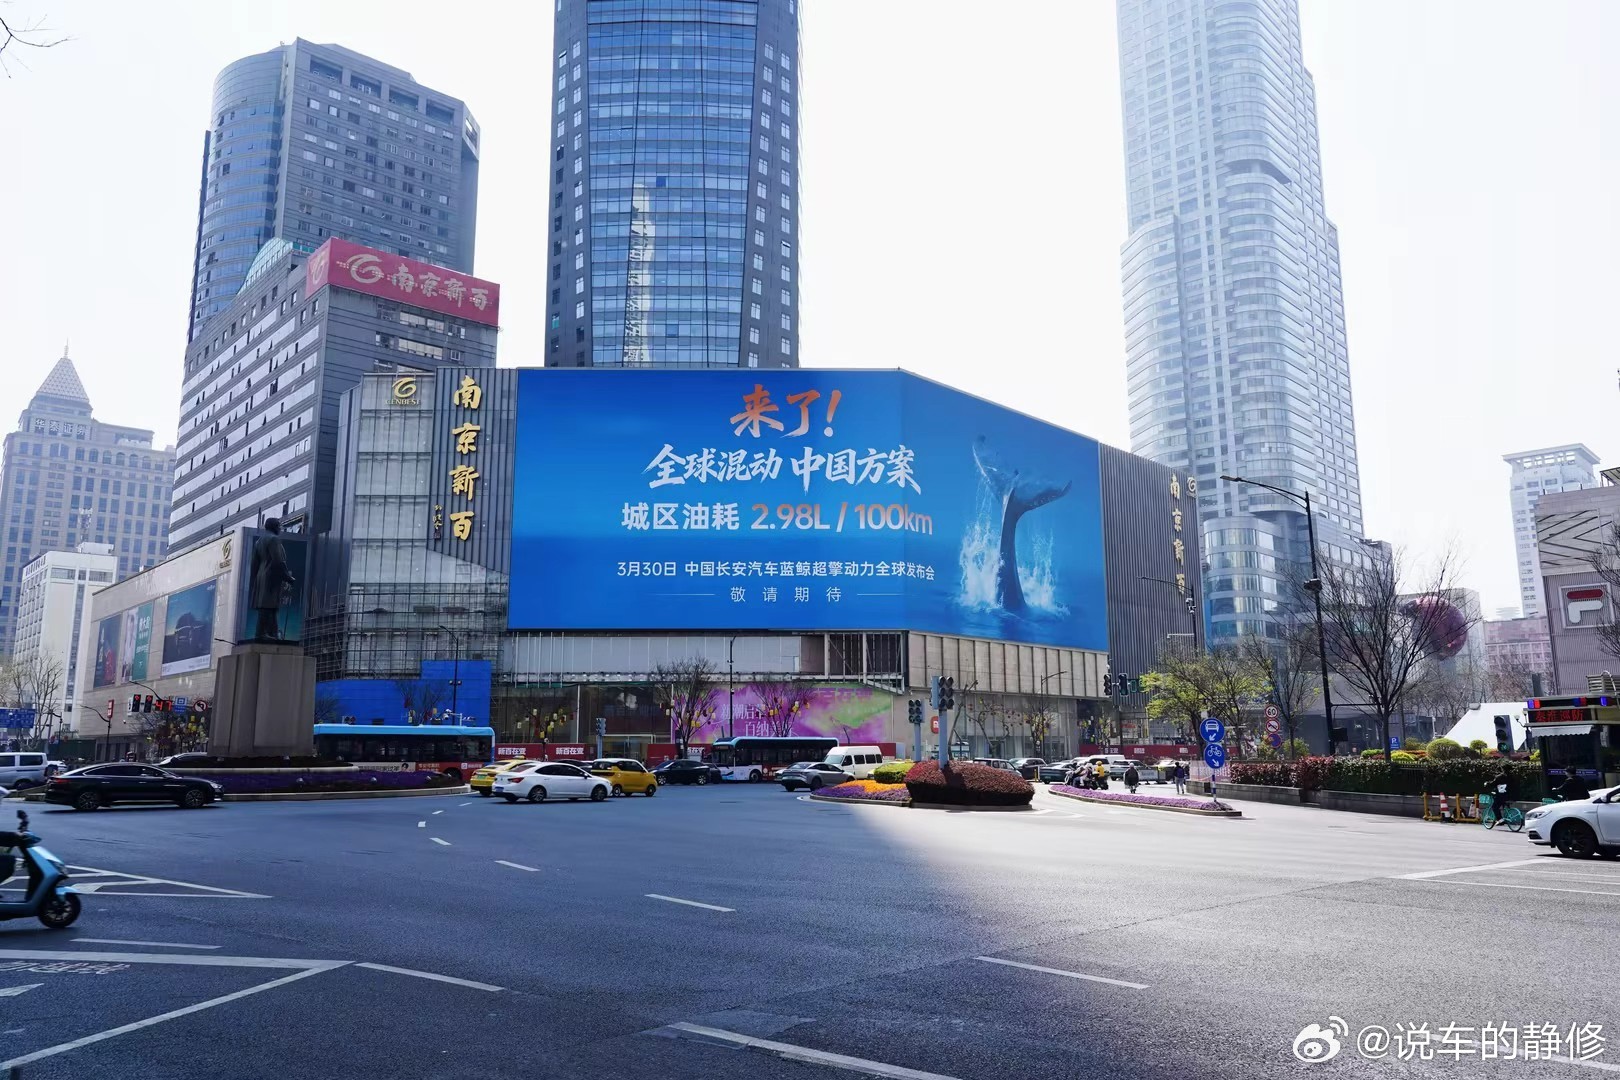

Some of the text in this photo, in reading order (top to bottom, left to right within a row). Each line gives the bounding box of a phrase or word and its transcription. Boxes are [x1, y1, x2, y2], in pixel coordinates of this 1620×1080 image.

[391, 263, 489, 311] 南京新百
[34, 419, 86, 436] 华泰证券
[448, 375, 482, 541] 南京新百
[640, 443, 922, 496] 全球混动 中国方案
[621, 502, 740, 531] 城区油耗
[750, 503, 830, 531] 2.98L
[854, 503, 934, 536] 100km
[616, 561, 936, 581] 3月30日 中国长安汽车蓝鲸超擎动力全球发布会
[155, 699, 173, 711] 47
